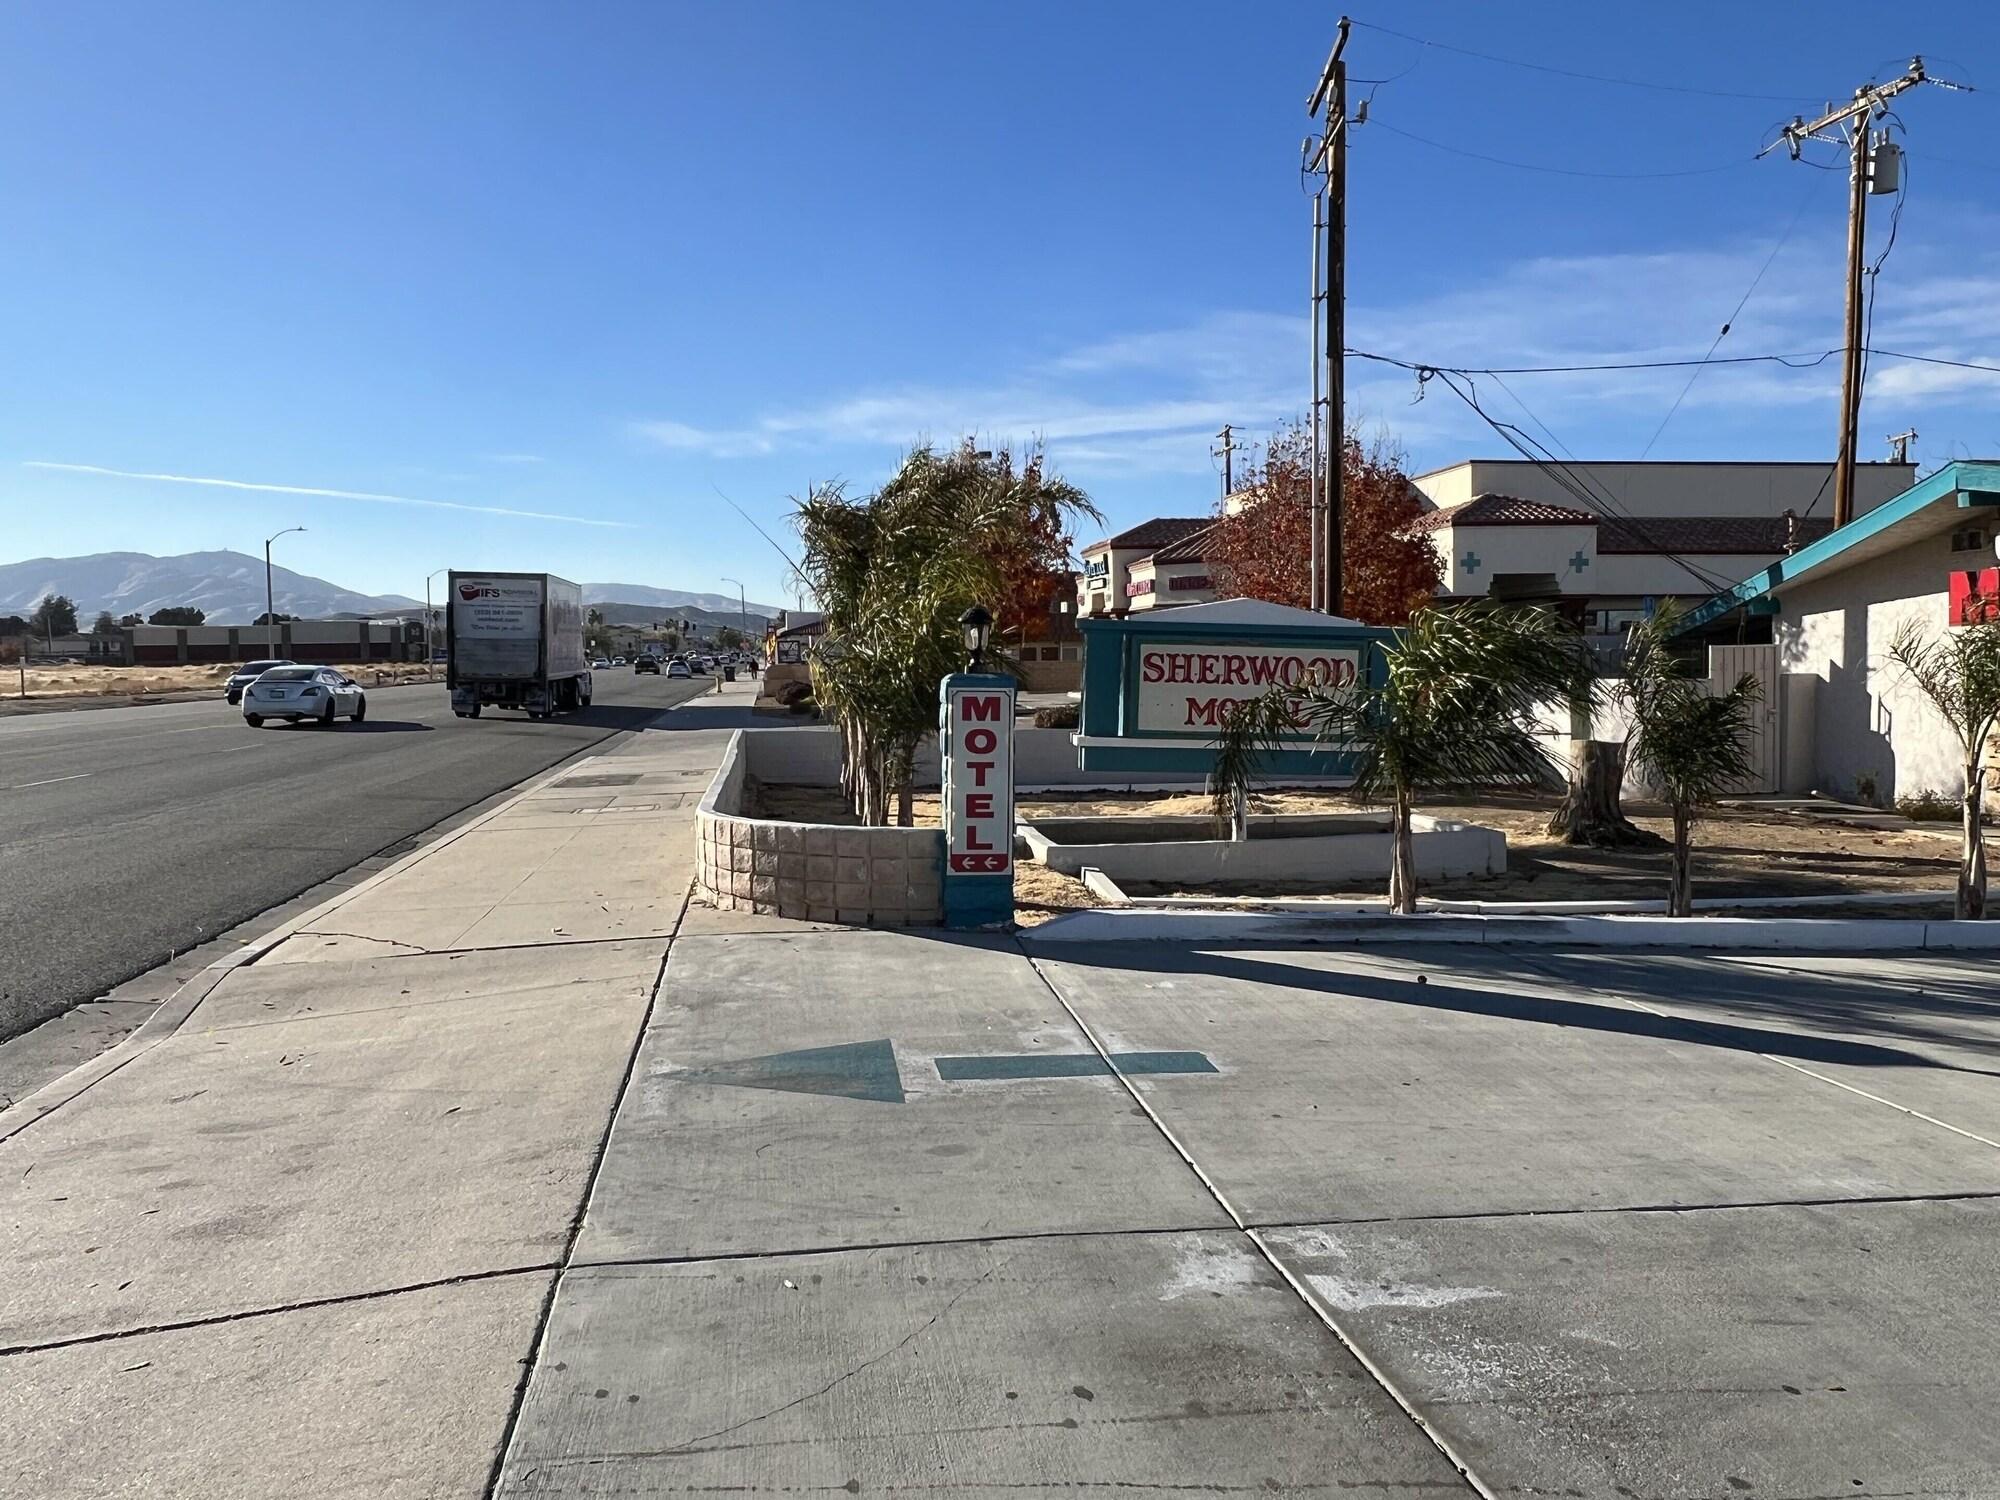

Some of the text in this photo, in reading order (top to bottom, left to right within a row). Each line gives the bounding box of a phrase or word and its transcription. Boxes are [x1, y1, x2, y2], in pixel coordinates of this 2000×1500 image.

[480, 588, 500, 598] IFS
[1143, 652, 1356, 688] SHERWOOD
[1183, 697, 1312, 728] MOL
[961, 696, 1001, 850] MOTEL
